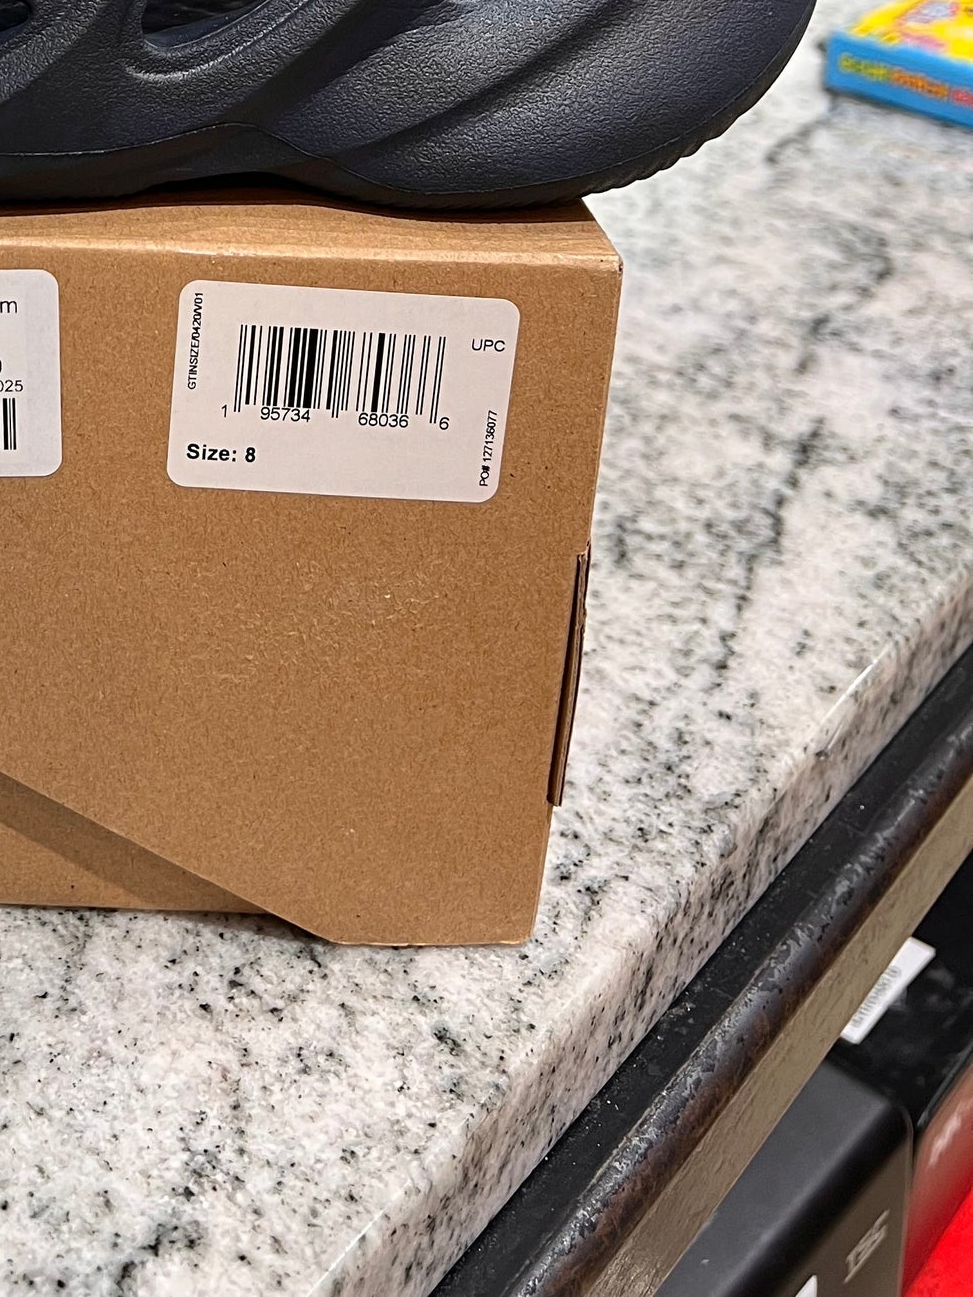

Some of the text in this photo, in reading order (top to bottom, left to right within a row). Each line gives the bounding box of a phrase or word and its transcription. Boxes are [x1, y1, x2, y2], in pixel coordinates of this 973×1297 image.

[471, 339, 506, 353] UPC
[221, 404, 450, 431] 1 95734 68036 6
[186, 443, 257, 463] Size: 8
[478, 410, 498, 487] PO# 127136077
